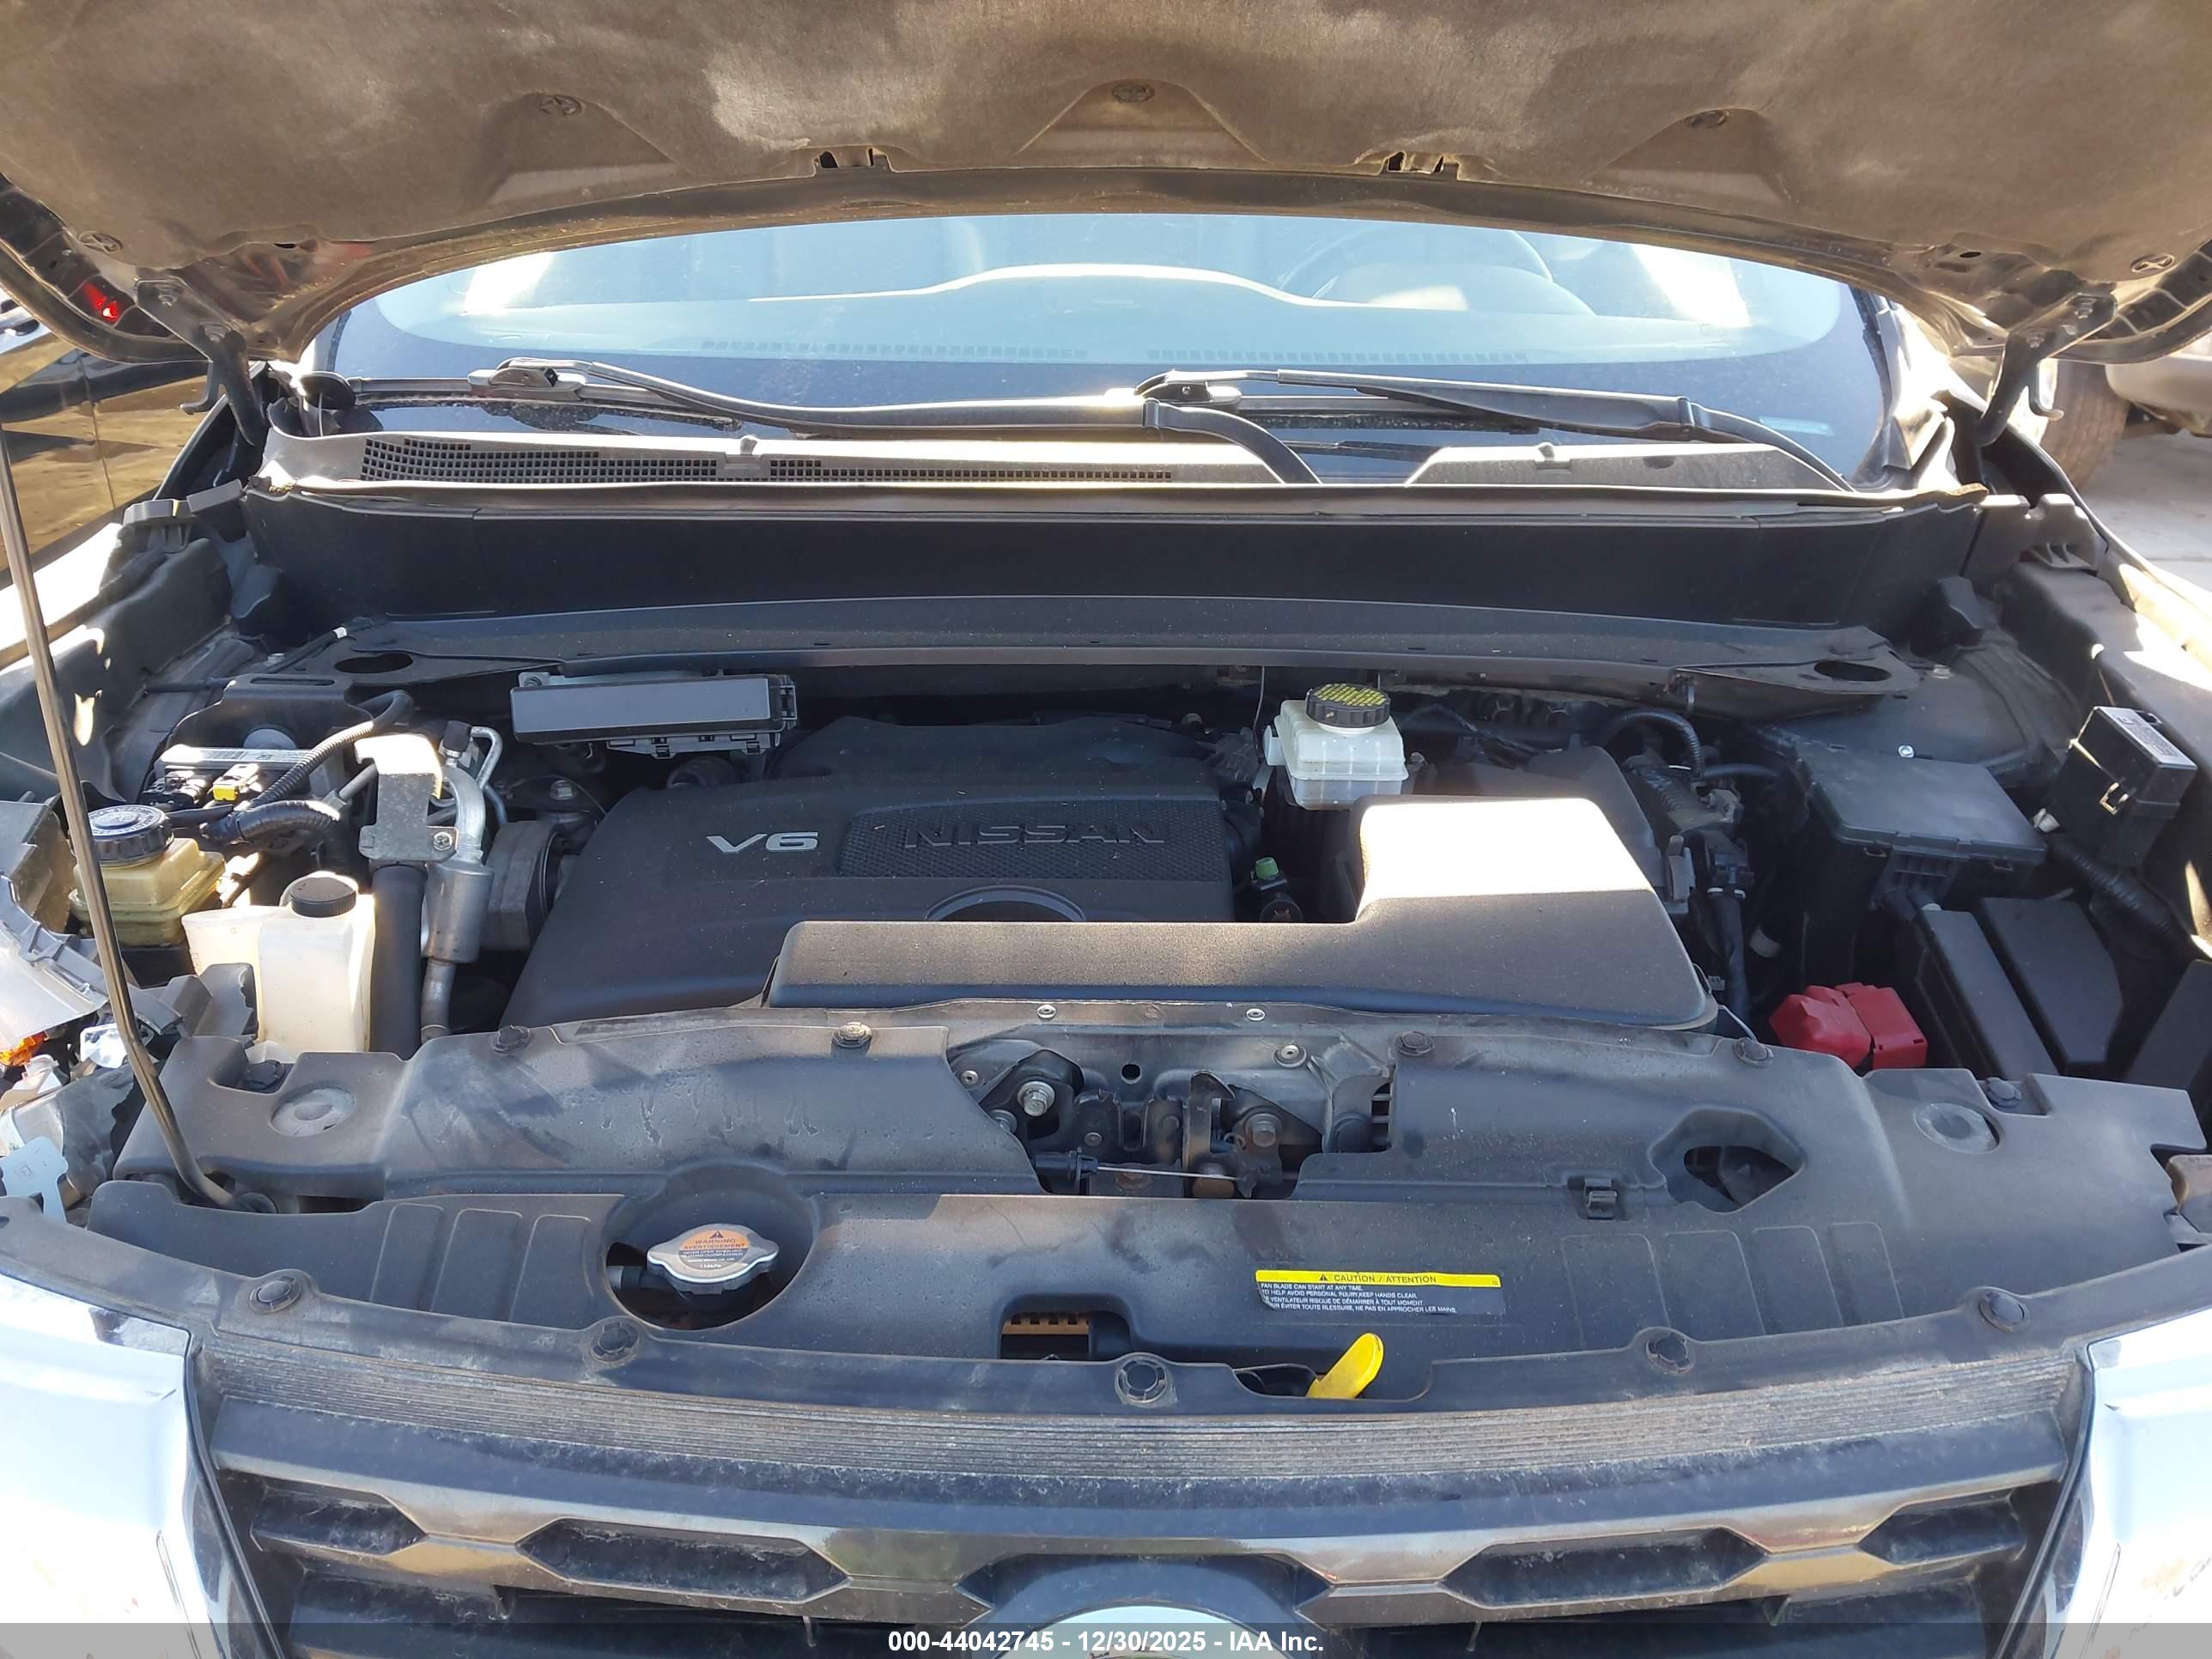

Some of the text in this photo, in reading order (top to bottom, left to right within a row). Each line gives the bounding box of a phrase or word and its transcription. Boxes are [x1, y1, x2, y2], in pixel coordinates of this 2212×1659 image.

[705, 823, 1165, 854] V6 NISSAN
[1334, 1274, 1376, 1283] CAUTION
[1386, 1275, 1437, 1284] ATTENTION
[1341, 1297, 1375, 1305] DÉMARRER
